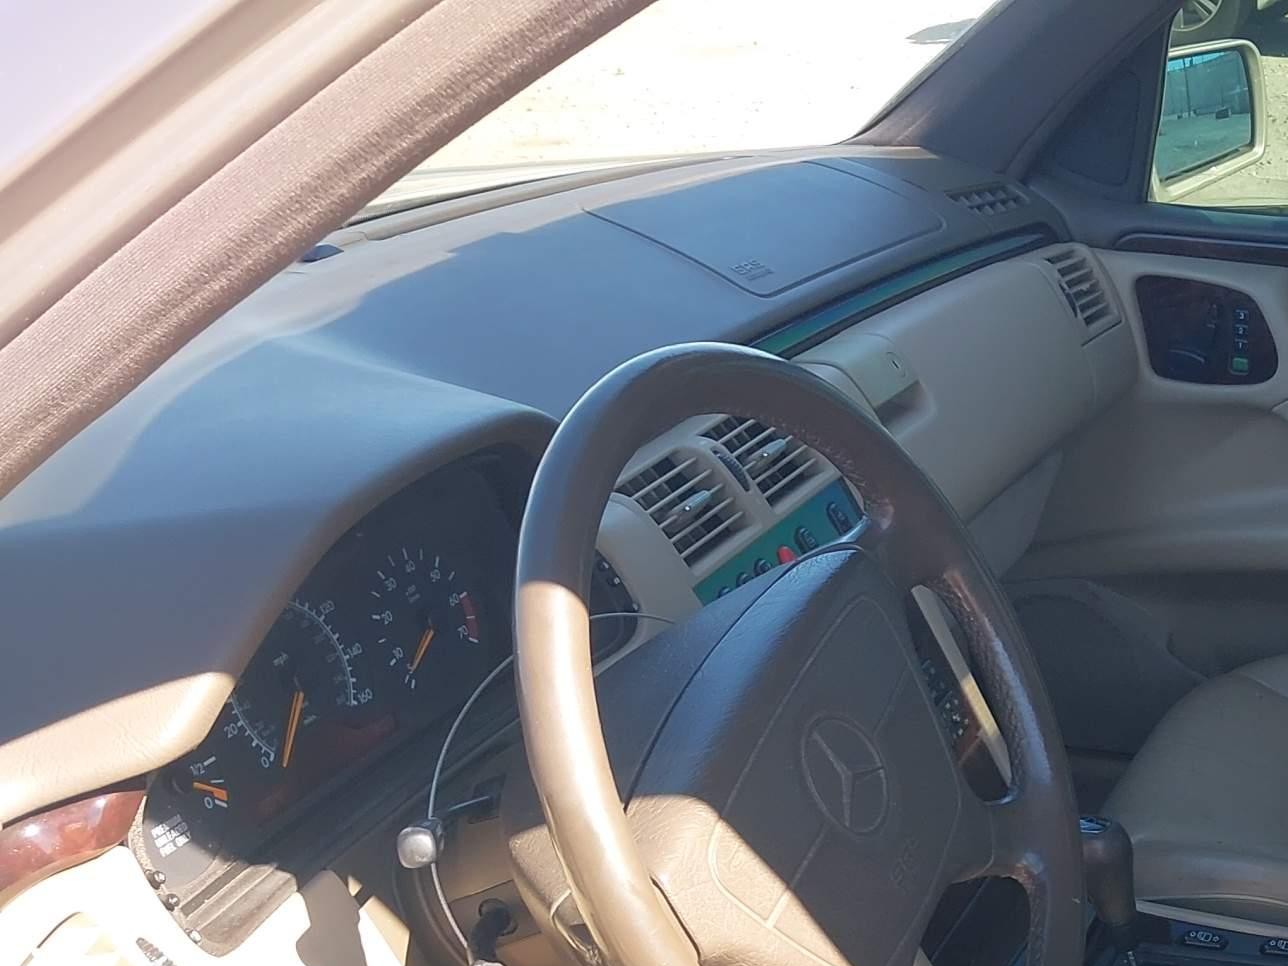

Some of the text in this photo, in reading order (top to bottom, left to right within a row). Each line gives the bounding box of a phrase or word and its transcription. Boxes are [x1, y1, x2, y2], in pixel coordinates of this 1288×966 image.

[384, 577, 397, 592] 30
[449, 593, 460, 607] 60
[381, 610, 393, 625] 20
[457, 625, 468, 639] 70
[392, 647, 404, 660] 10
[357, 688, 373, 705] 160
[224, 723, 239, 739] 20
[260, 756, 270, 768] 0
[190, 763, 205, 776] 1/2
[203, 796, 214, 809] 0
